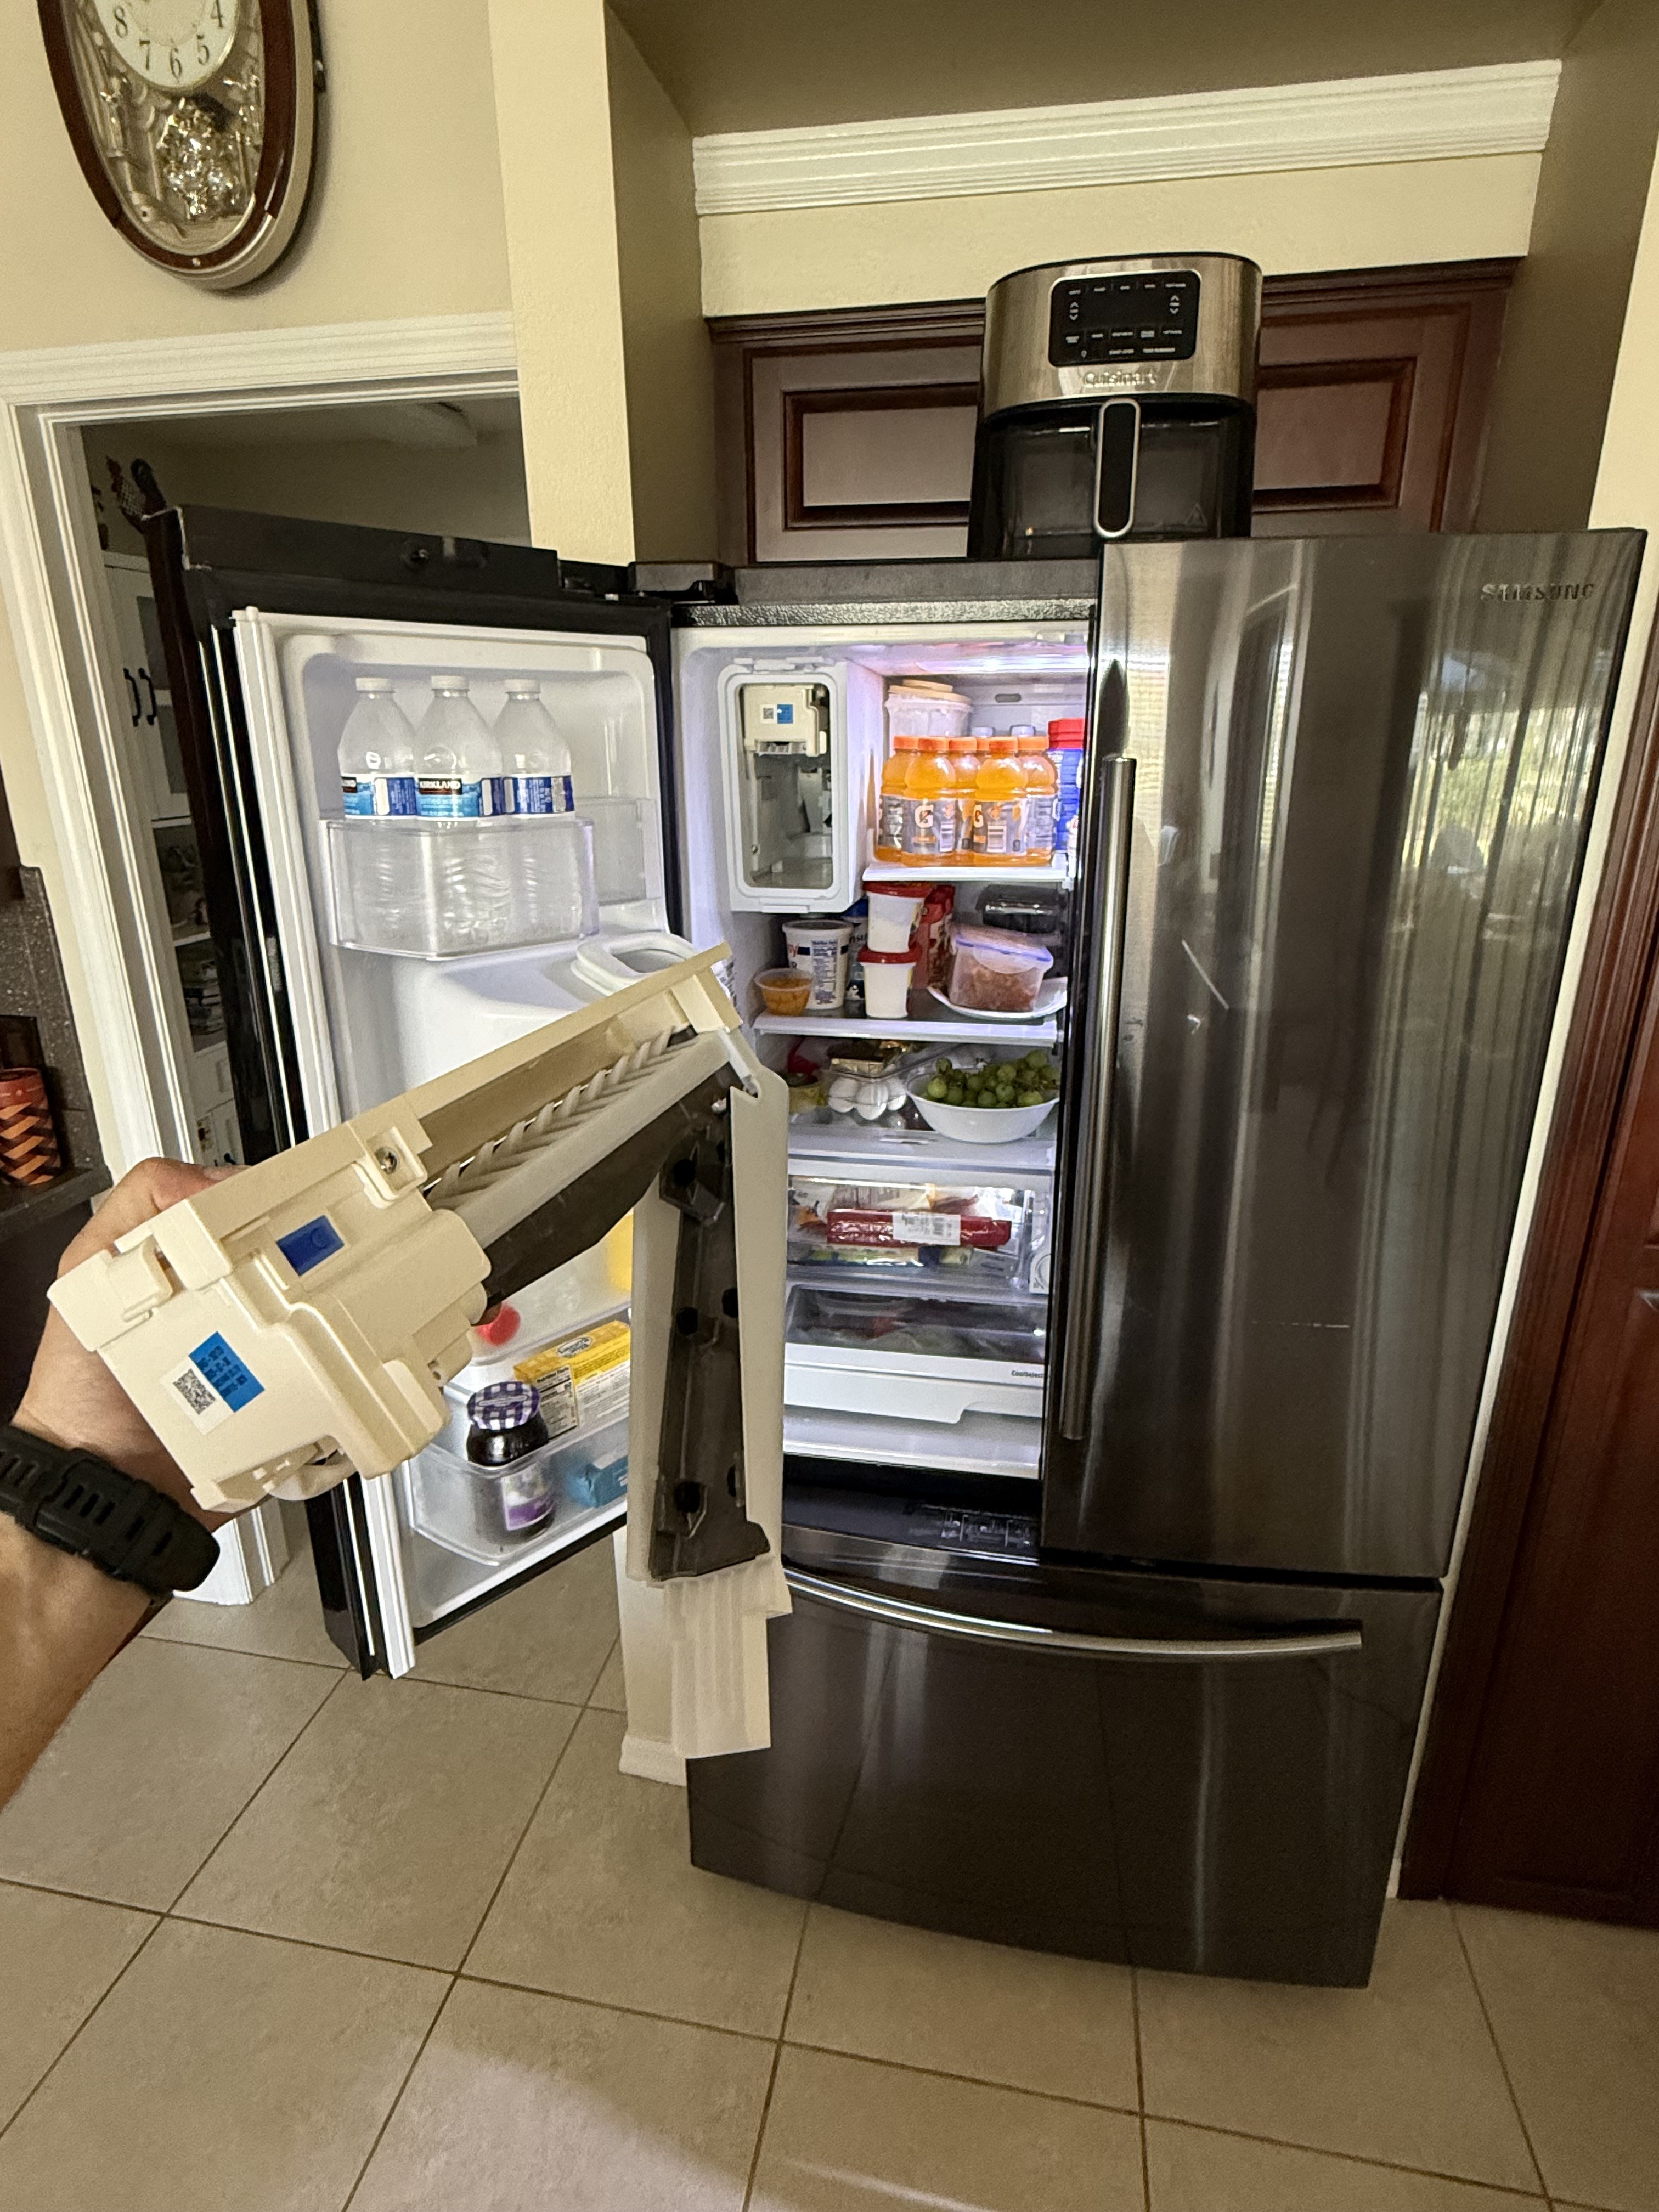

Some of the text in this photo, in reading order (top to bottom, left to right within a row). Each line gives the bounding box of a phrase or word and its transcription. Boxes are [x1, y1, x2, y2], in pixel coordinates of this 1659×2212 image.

[114, 6, 128, 38] 8
[210, 0, 224, 28] 4
[139, 39, 150, 71] 7
[169, 48, 182, 79] 6
[197, 34, 210, 66] 5
[1083, 369, 1157, 388] Cuisinart
[1480, 583, 1595, 602] SAMSUNG
[915, 805, 934, 828] G
